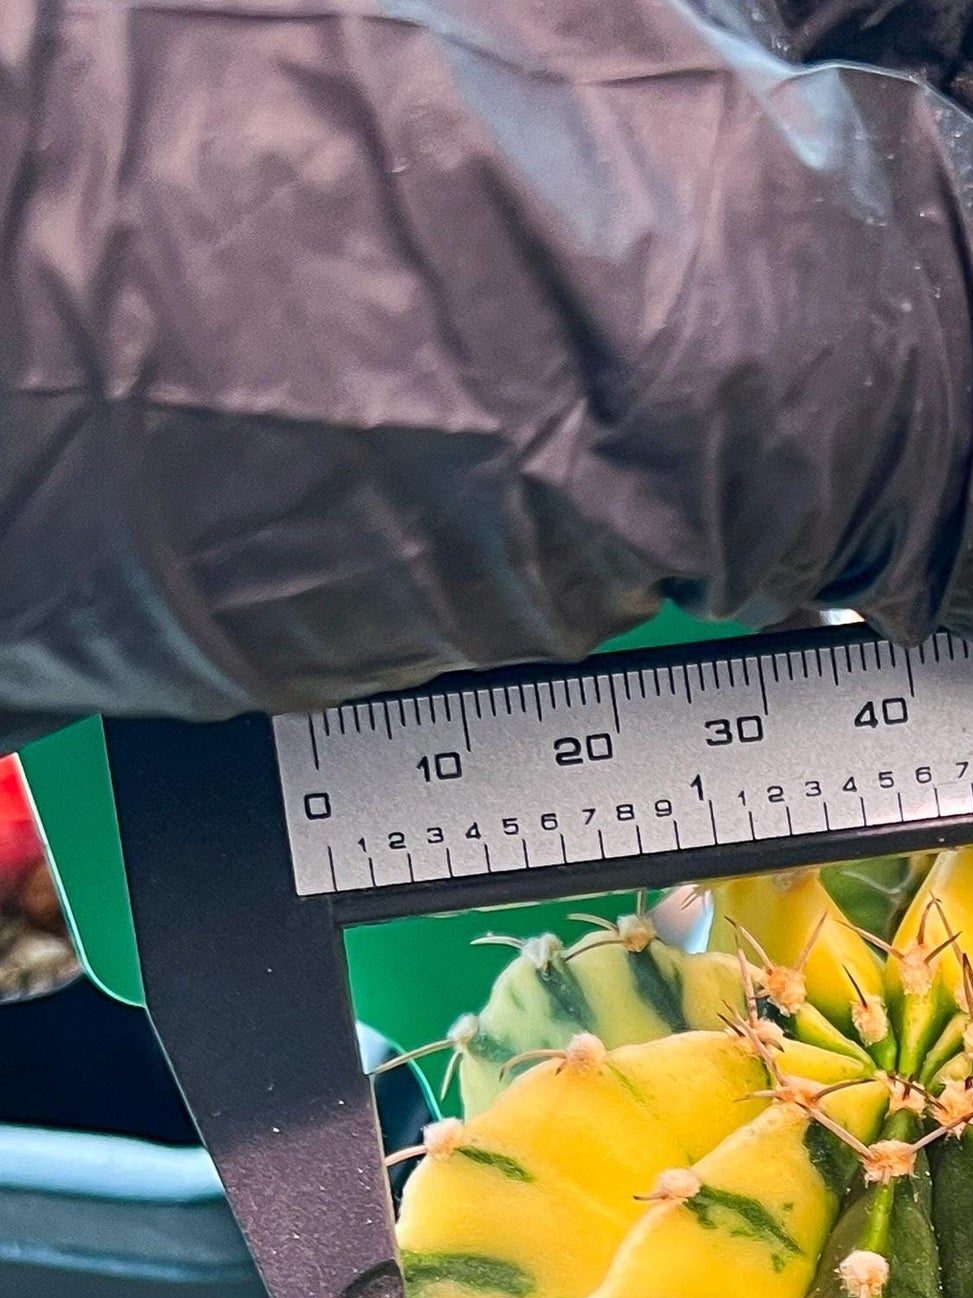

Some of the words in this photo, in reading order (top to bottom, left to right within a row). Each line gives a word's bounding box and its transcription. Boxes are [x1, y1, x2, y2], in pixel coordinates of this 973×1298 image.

[303, 792, 332, 821] 0
[416, 751, 463, 783] 10
[553, 732, 613, 767] 20
[704, 715, 764, 747] 30
[854, 697, 909, 729] 40
[357, 837, 367, 853] 1
[387, 831, 407, 850] 2
[426, 826, 445, 844] 3
[465, 821, 482, 840] 4
[501, 817, 519, 836] 5
[540, 812, 558, 831] 6
[581, 808, 596, 826] 7
[615, 803, 635, 822] 8
[654, 799, 673, 818] 9
[690, 773, 704, 801] 1
[737, 790, 746, 807] 1
[766, 785, 785, 803] 2
[804, 780, 822, 797] 3
[842, 776, 858, 793] 4
[878, 770, 895, 789] 5
[914, 766, 932, 784] 6
[955, 761, 969, 779] 7
